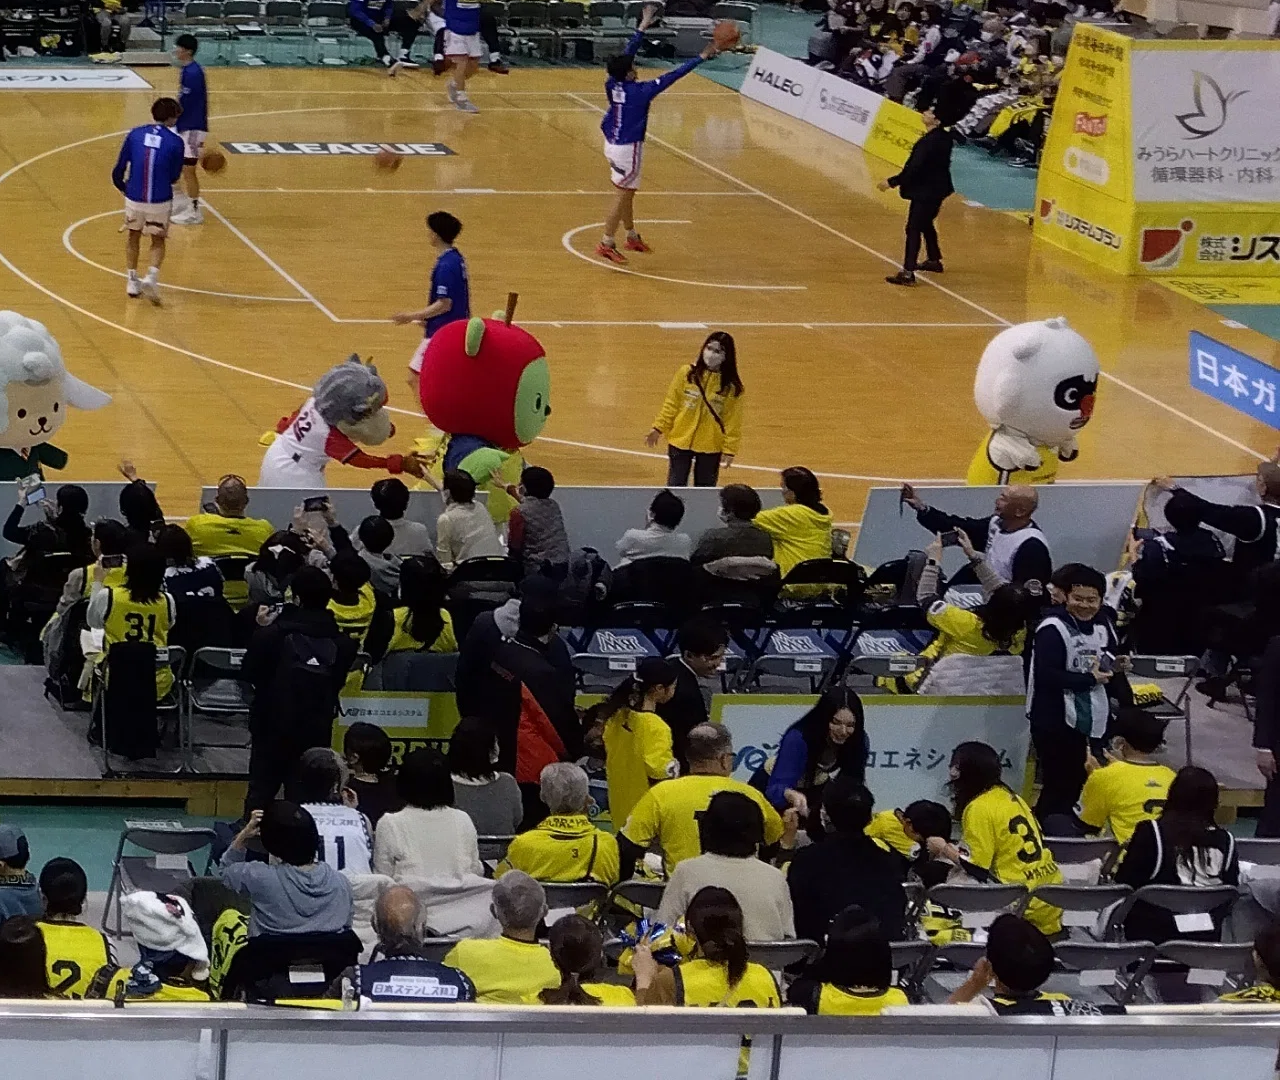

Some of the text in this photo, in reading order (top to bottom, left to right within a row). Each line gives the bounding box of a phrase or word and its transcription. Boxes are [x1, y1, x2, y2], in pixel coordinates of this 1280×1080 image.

[753, 66, 804, 97] HALEO
[228, 142, 447, 155] B.LEAGUE
[1150, 166, 1275, 183] 循環器科・内科
[1063, 216, 1122, 250] システムプラン
[1196, 349, 1277, 413] 日本ガ
[125, 611, 156, 642] 31
[571, 847, 580, 859] 3
[1008, 815, 1043, 864] 3
[51, 959, 81, 1000] 2
